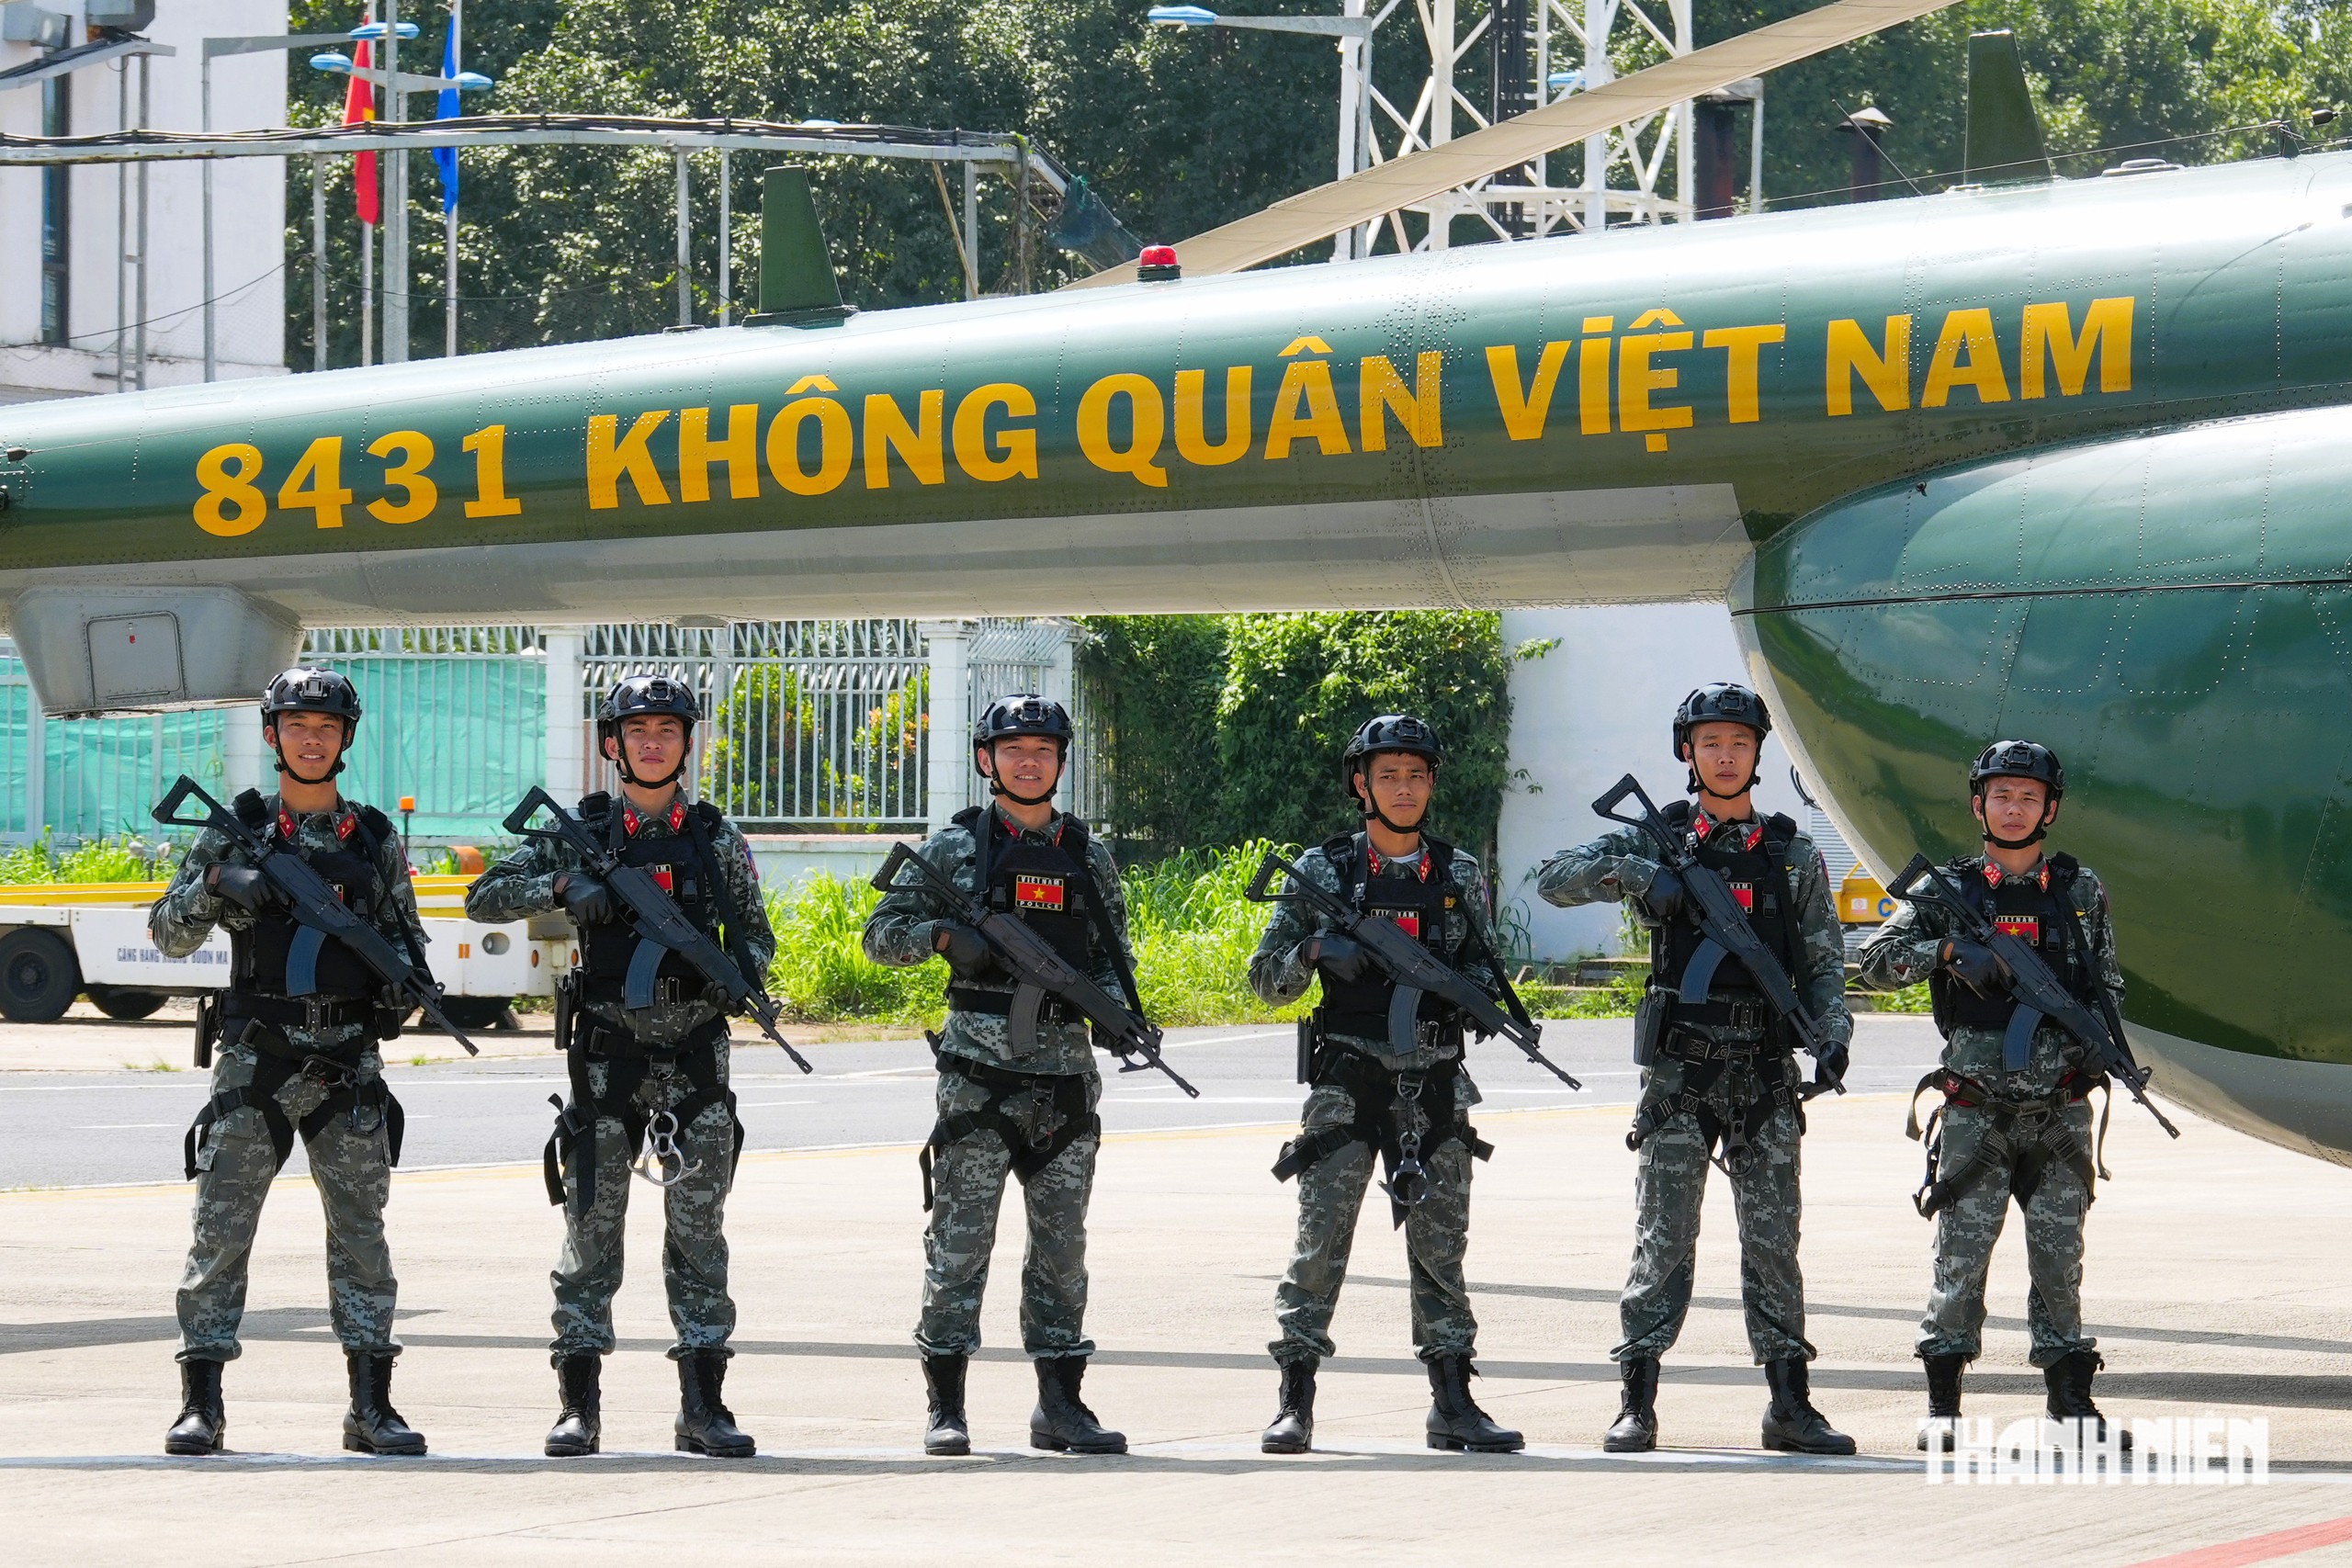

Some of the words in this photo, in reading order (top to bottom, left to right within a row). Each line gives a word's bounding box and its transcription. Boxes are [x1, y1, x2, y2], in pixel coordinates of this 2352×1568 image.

[192, 425, 522, 537] 8431
[587, 375, 1039, 510] KHÔNG
[1076, 336, 1443, 488] QUÂN
[1826, 297, 2134, 416] NAM
[1021, 875, 1060, 886] VIETNAM
[1020, 900, 1059, 909] POLICE
